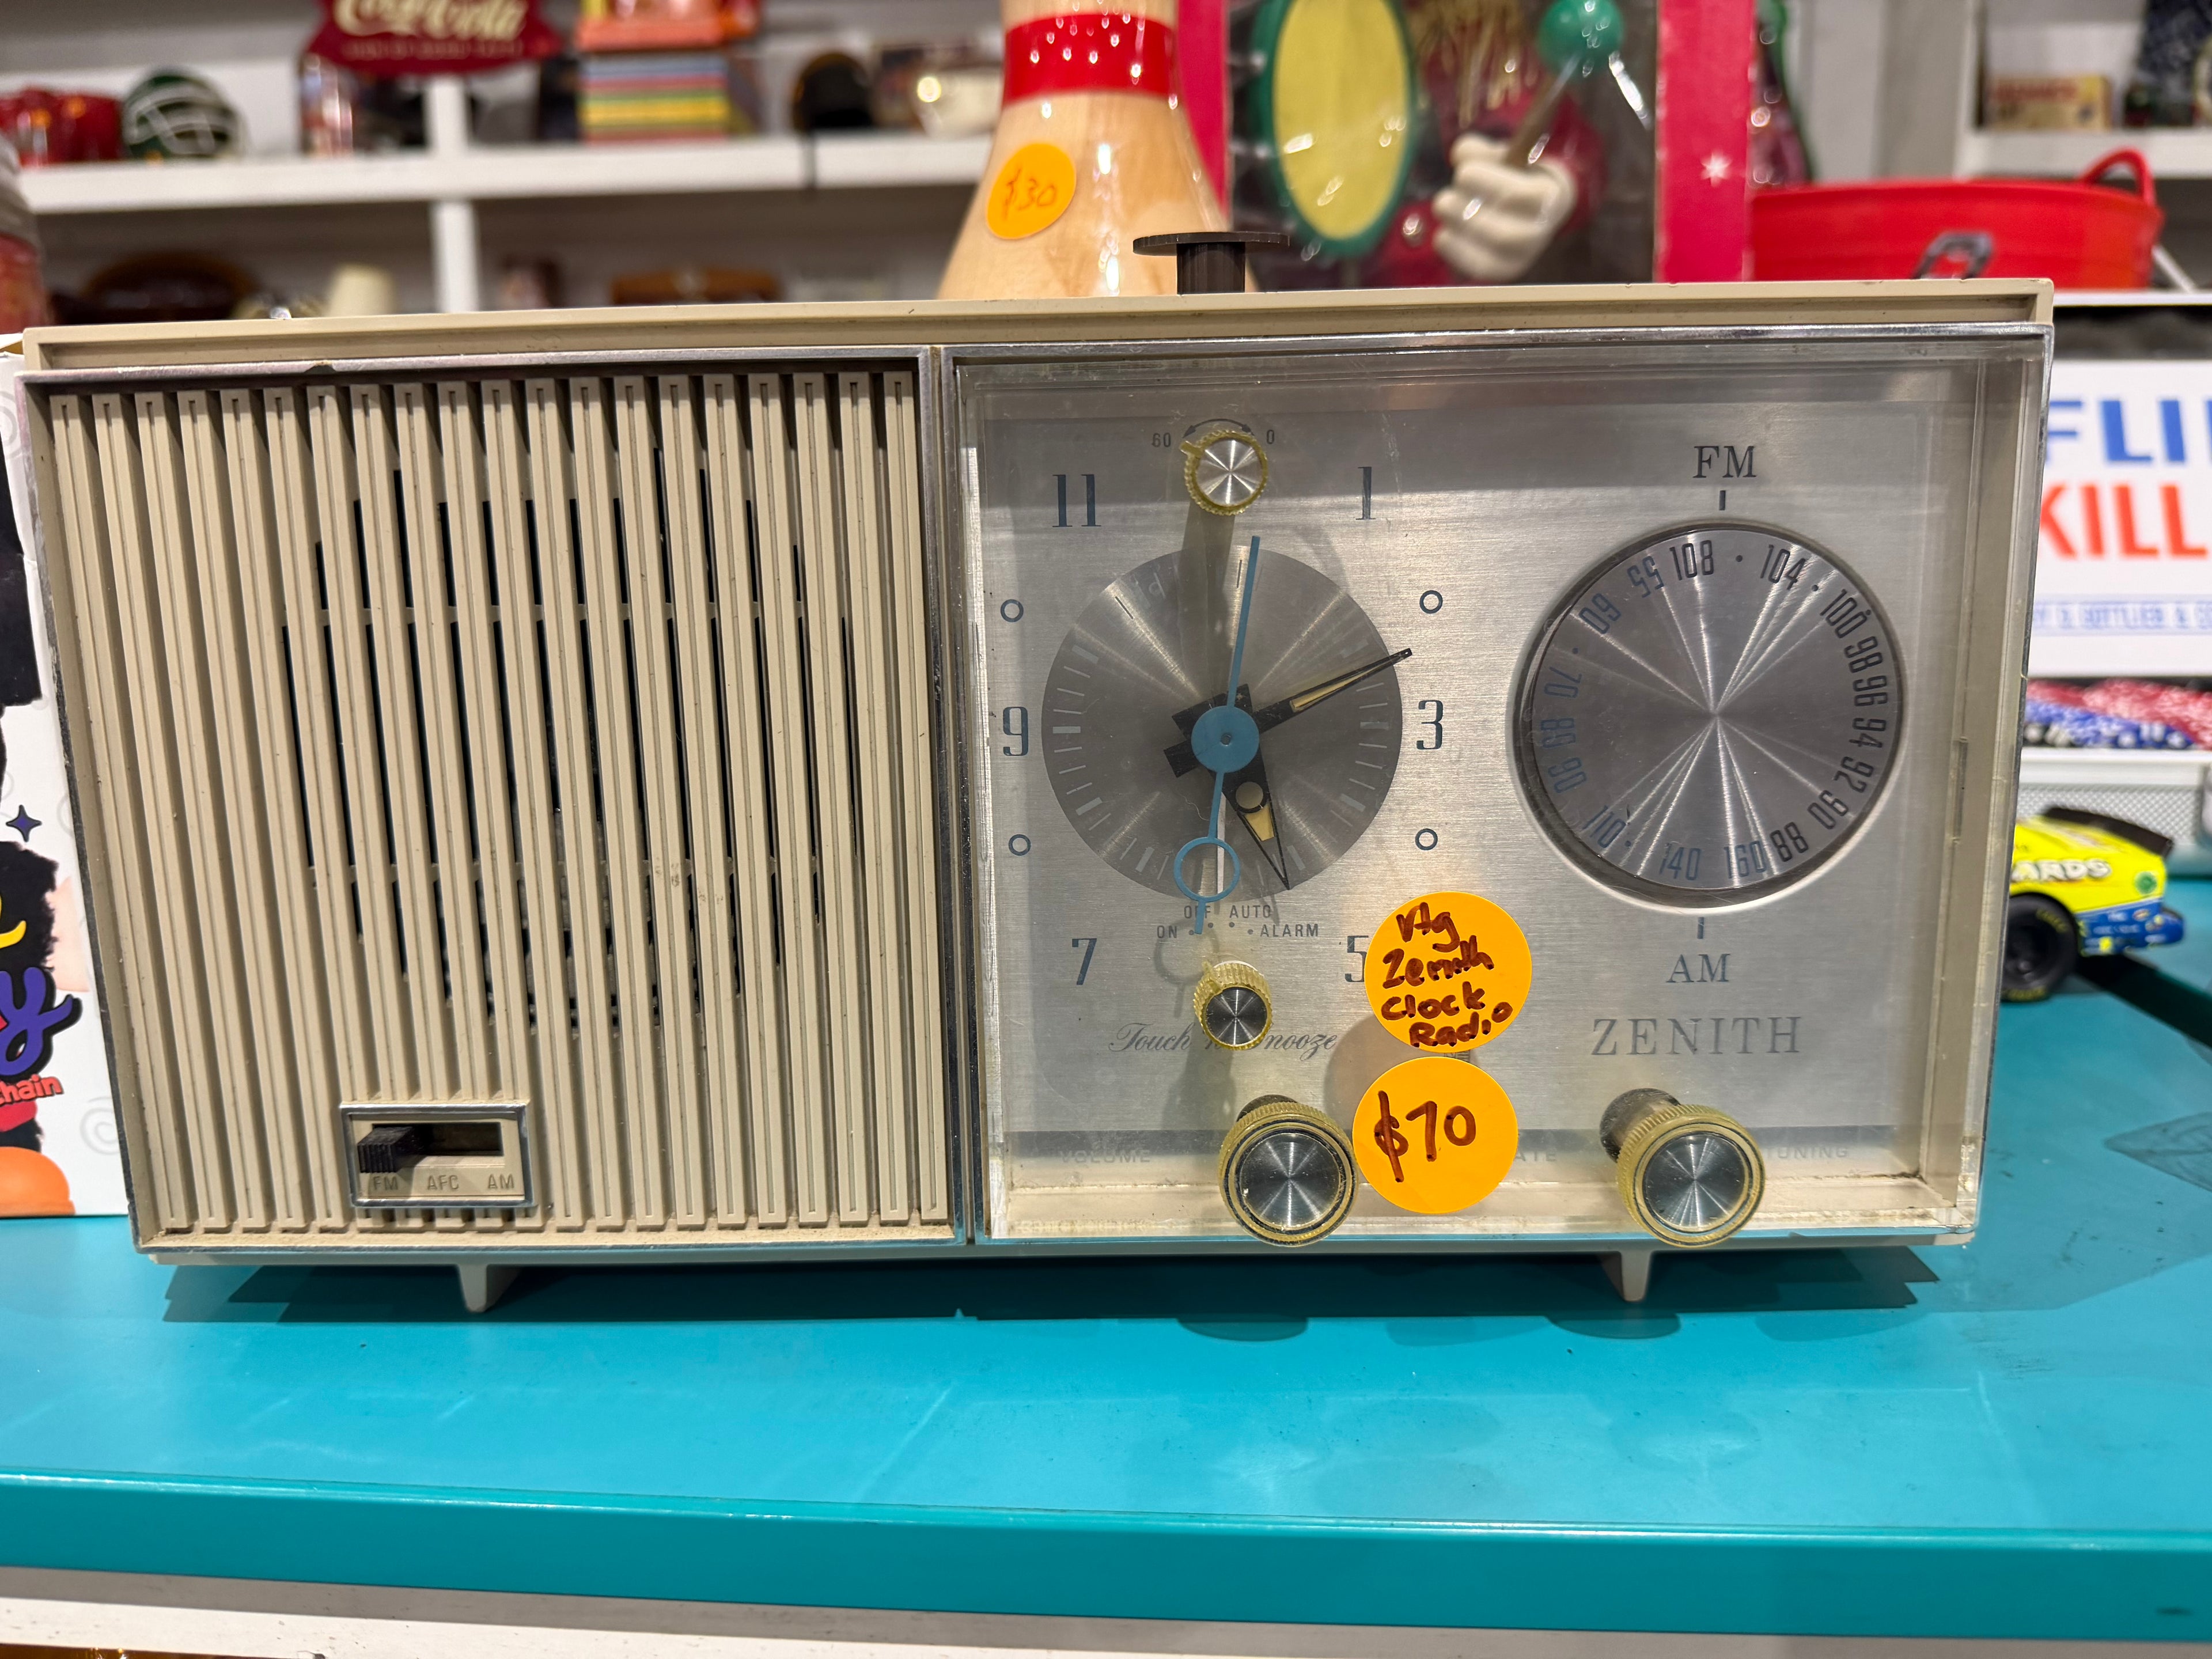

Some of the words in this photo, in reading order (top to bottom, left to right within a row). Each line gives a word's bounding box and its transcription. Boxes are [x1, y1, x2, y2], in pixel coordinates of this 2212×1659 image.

[1001, 167, 1057, 221] $30
[1152, 432, 1171, 448] 60
[2047, 397, 2212, 464] FLI
[1692, 445, 1757, 479] FM
[1052, 474, 1101, 528] 11
[1355, 466, 1377, 520] 1
[1626, 556, 1666, 598] 55
[1669, 540, 1714, 581] 108
[1759, 544, 1806, 590] 104
[1578, 592, 1621, 634] 60
[1819, 589, 1868, 639] 100
[1844, 635, 1884, 673] 98
[1542, 666, 1582, 699] 70
[1853, 675, 1888, 708] 96
[1002, 706, 1029, 756] 9
[1415, 699, 1444, 750] 3
[1540, 717, 1577, 748] 80
[1848, 717, 1887, 748] 94
[1547, 756, 1588, 794] 90
[1834, 756, 1874, 794] 92
[1583, 805, 1627, 849] 110
[1806, 790, 1850, 830] 90
[1658, 842, 1702, 881] 140
[1727, 840, 1767, 878] 160
[1770, 821, 1809, 862] 88
[1156, 925, 1177, 939] ON
[1259, 923, 1319, 938] ALARM
[1229, 904, 1271, 919] AUTO
[1071, 937, 1097, 985] 7
[1344, 935, 1369, 983] 5
[1665, 953, 1730, 983] AM
[1108, 1022, 1196, 1052] Touch
[1264, 1022, 1338, 1062] nooze
[1409, 1001, 1514, 1048] Radio
[1591, 1016, 1801, 1056] ZENITH
[0, 1074, 63, 1104] hain
[1373, 1090, 1476, 1183] $70
[1060, 1150, 1151, 1164] VOLUME
[372, 1176, 399, 1191] FM
[427, 1174, 460, 1191] AFC
[487, 1173, 515, 1190] AM
